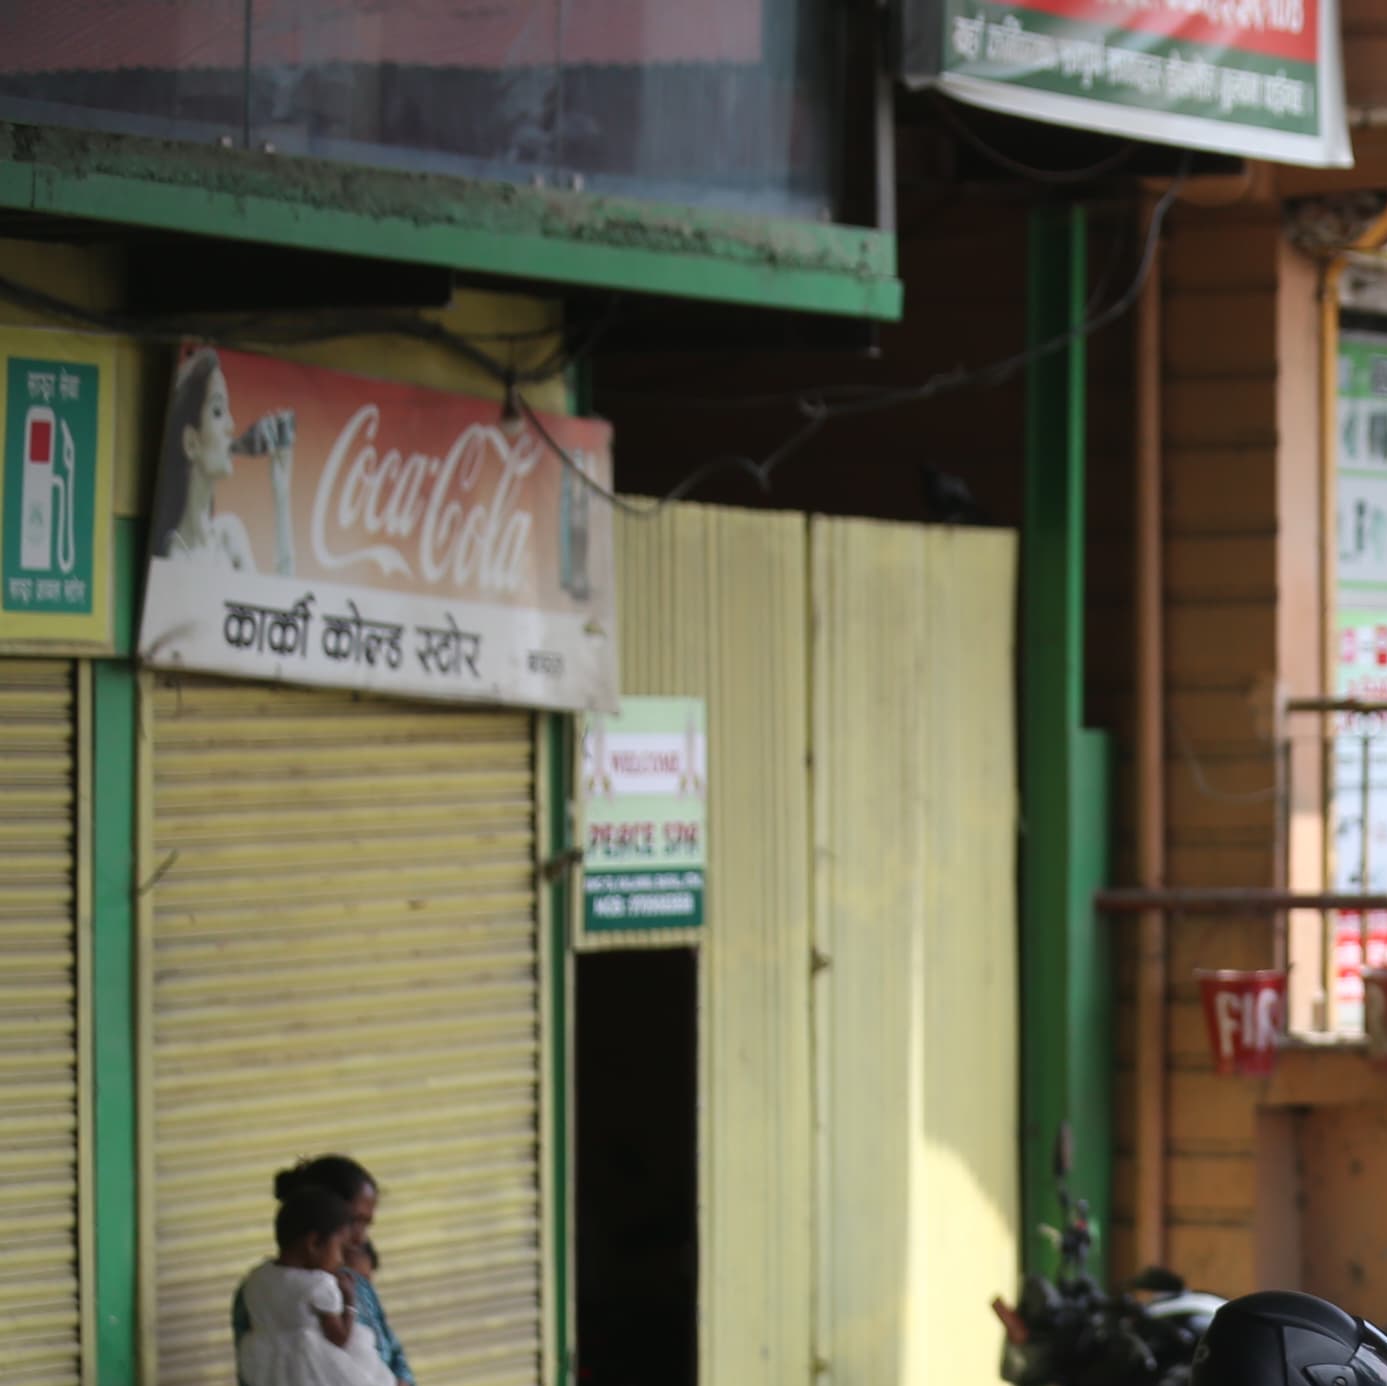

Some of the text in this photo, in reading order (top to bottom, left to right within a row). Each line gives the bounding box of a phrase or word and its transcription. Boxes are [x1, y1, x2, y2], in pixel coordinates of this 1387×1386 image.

[309, 401, 546, 593] Coca-Cola
[223, 592, 316, 660] कार्की
[322, 597, 405, 672] कोल्ड
